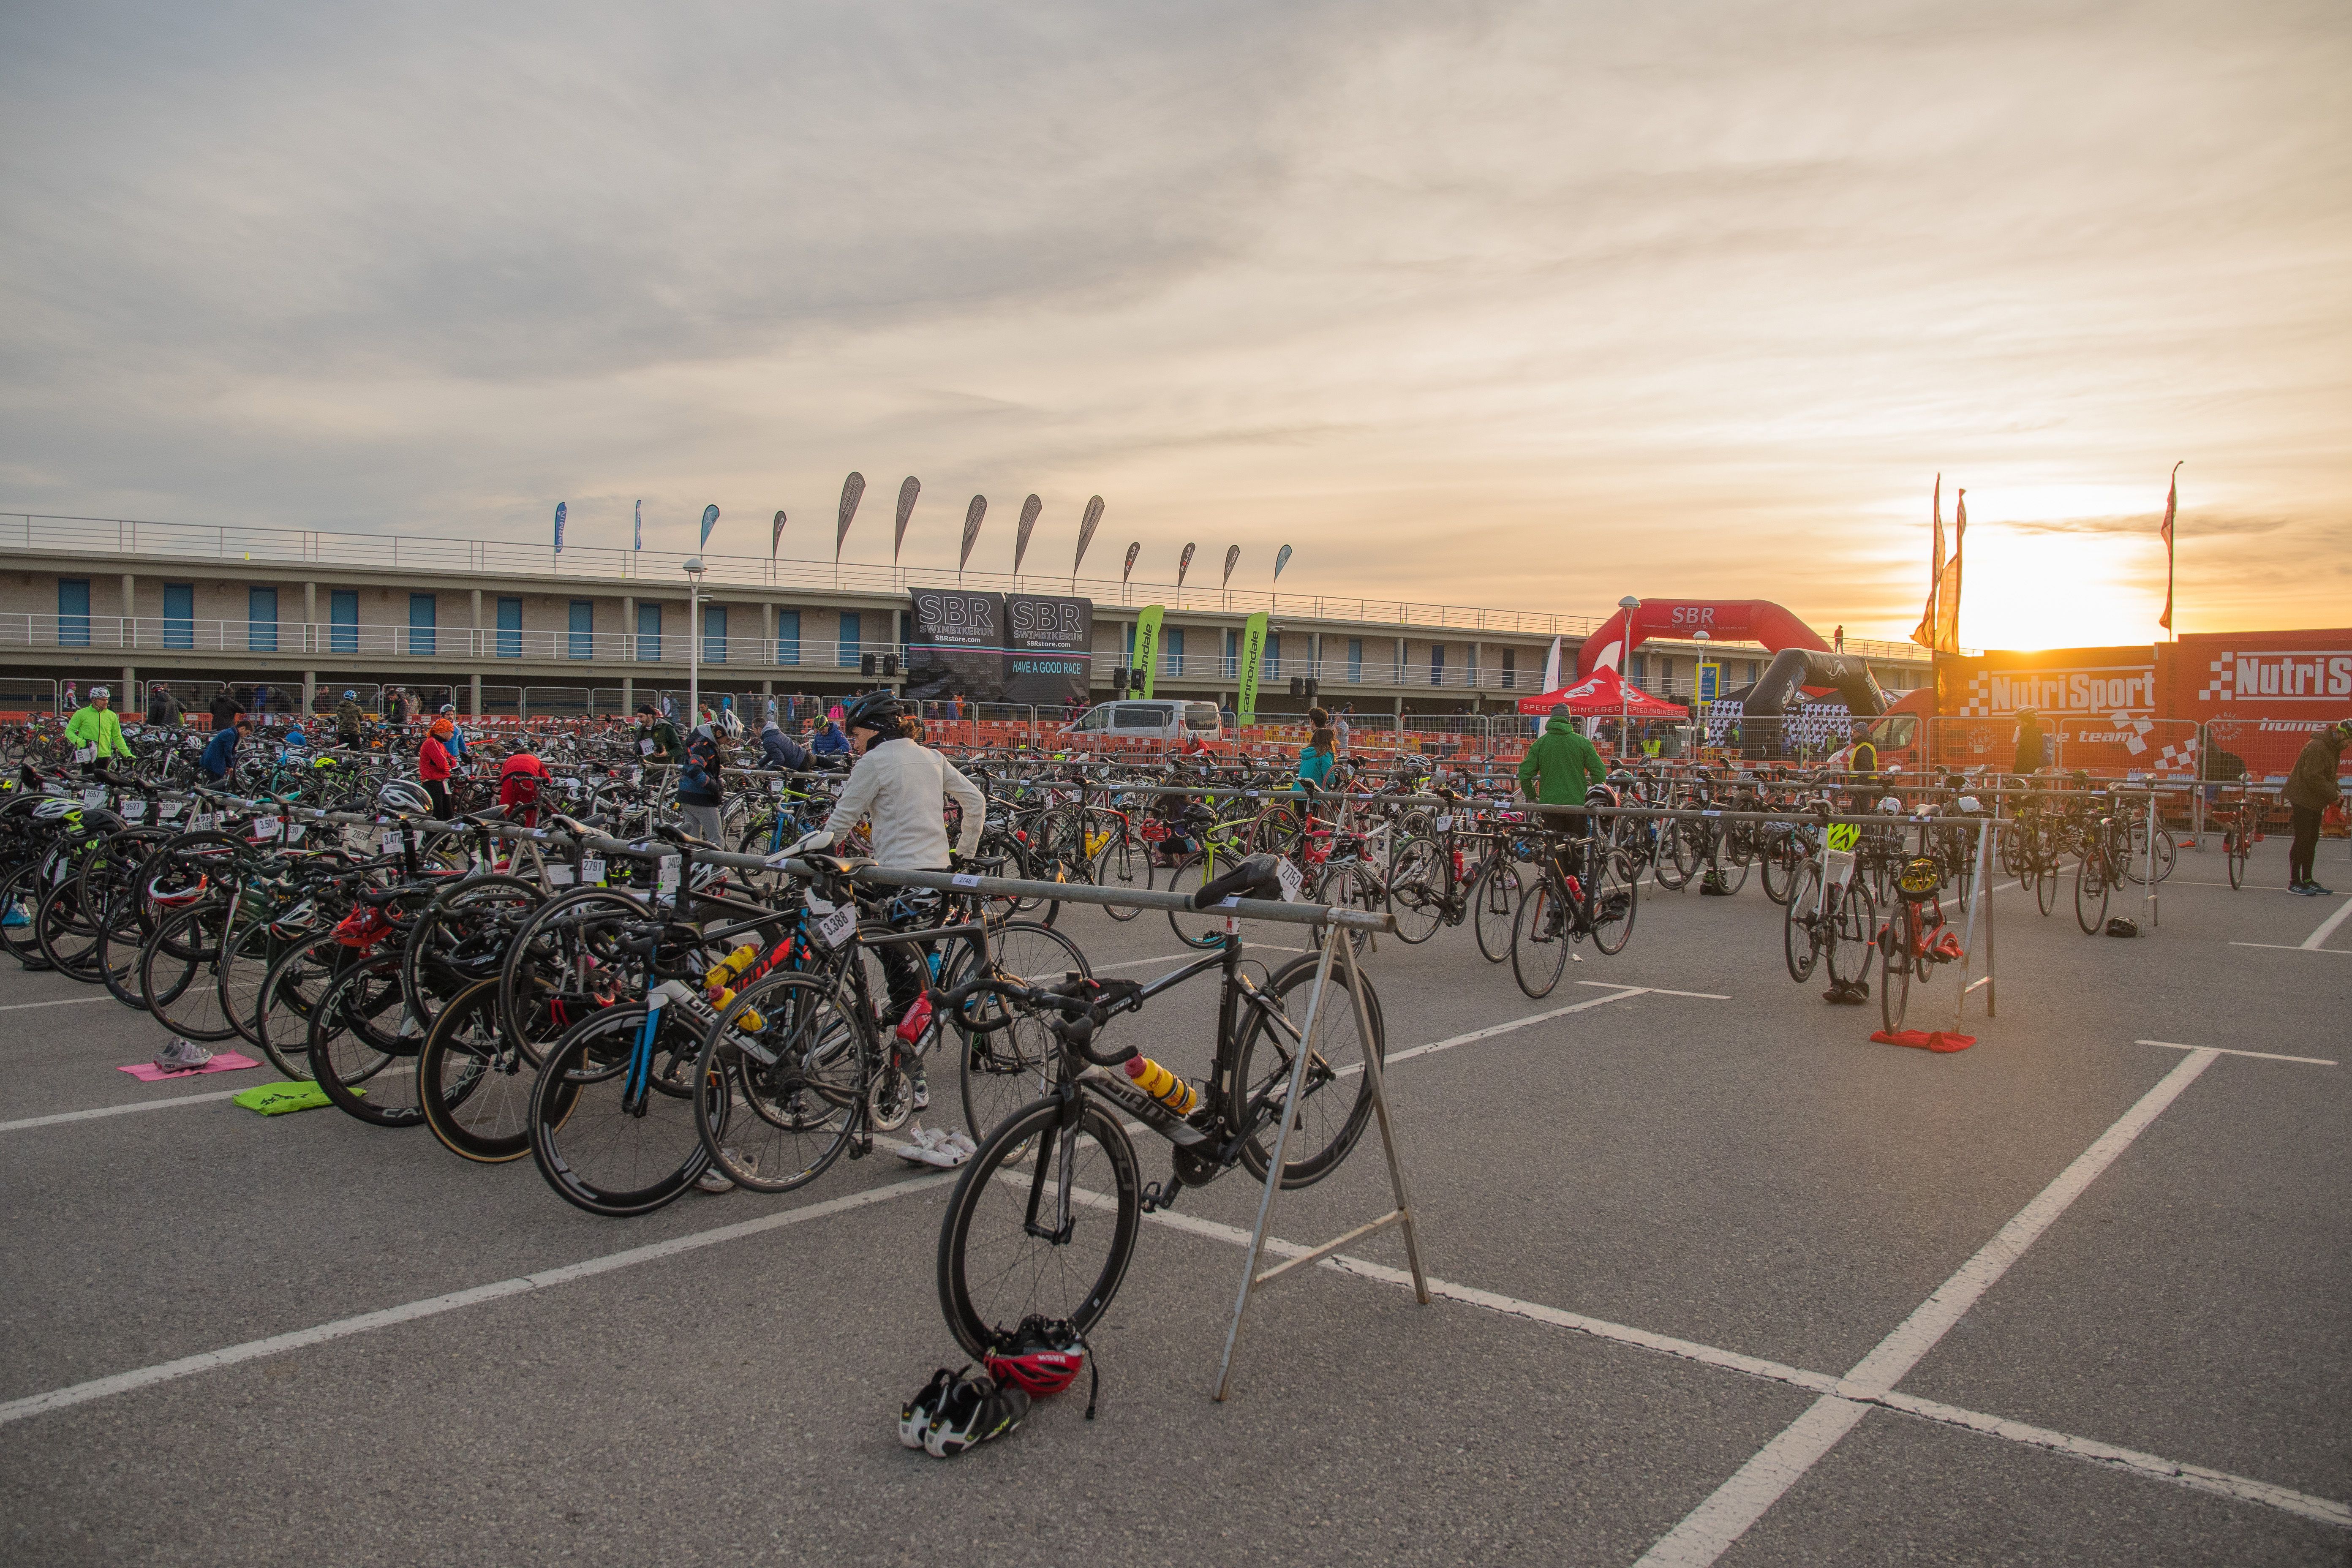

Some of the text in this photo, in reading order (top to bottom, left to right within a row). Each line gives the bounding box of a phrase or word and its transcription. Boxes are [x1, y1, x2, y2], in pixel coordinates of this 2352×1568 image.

[1125, 546, 1137, 572] POLAR
[1180, 546, 1192, 572] POLAR
[1226, 550, 1238, 574] orca
[919, 595, 994, 627] SBR
[1013, 601, 1082, 632] SBR
[1671, 607, 1715, 624] SBR
[920, 624, 994, 636] SWIMBIKERUN
[1014, 630, 1082, 641] SWIMBIKERUN
[1013, 661, 1082, 675] HAVE A GOOD RACE!
[1244, 630, 1260, 711] cannondale
[1782, 680, 1795, 709] sail
[1865, 675, 1878, 695] sail
[1991, 671, 2155, 714] NutriSport
[2079, 728, 2135, 743] team
[2259, 717, 2327, 731] home
[260, 819, 276, 828] 3.501
[384, 833, 400, 845] 3.477
[584, 860, 602, 871] 2791
[667, 856, 680, 869] 3403
[1282, 864, 1301, 889] 2752
[823, 911, 849, 936] 3.388
[942, 937, 955, 970] QUART
[320, 968, 373, 1030] BORA
[1109, 1081, 1177, 1127] GIANT
[1037, 1354, 1065, 1364] KASK
